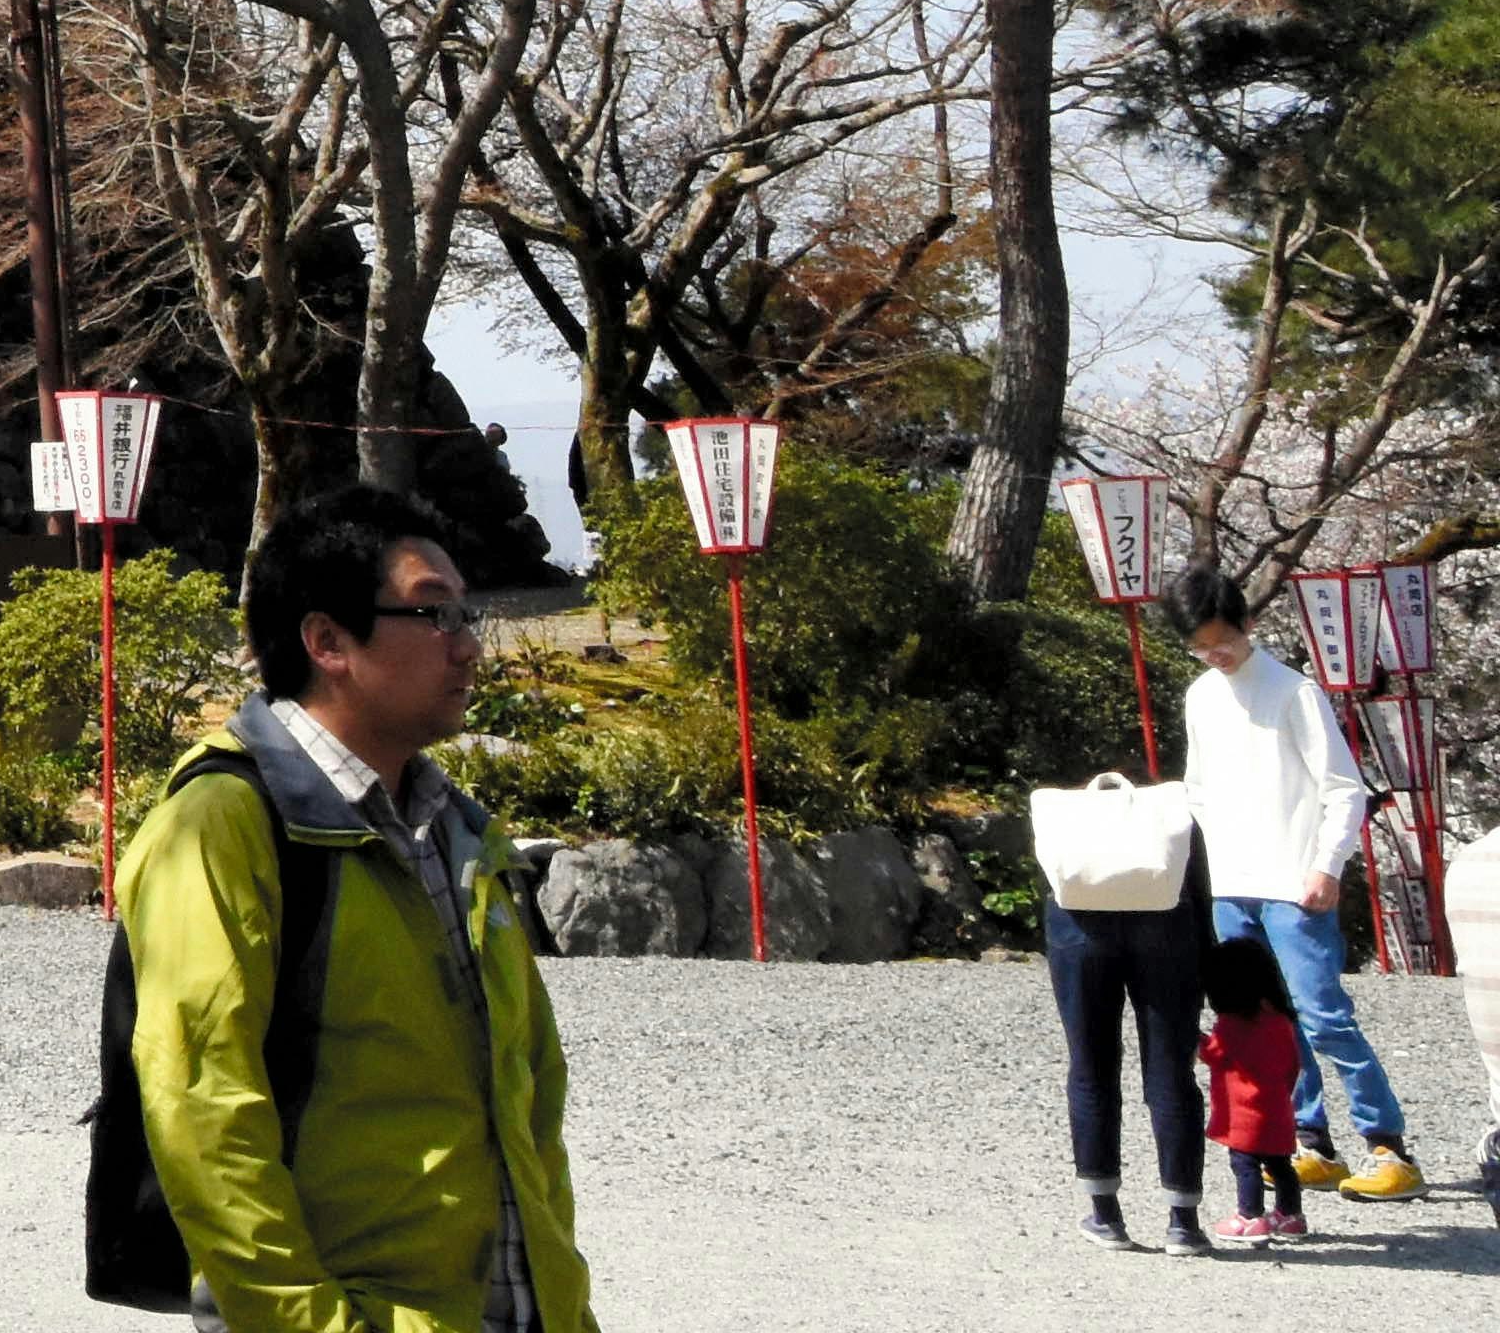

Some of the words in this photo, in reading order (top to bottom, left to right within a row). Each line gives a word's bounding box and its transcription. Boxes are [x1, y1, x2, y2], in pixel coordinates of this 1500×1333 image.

[78, 445, 91, 501] 2300
[1114, 516, 1140, 590] フクイヤ
